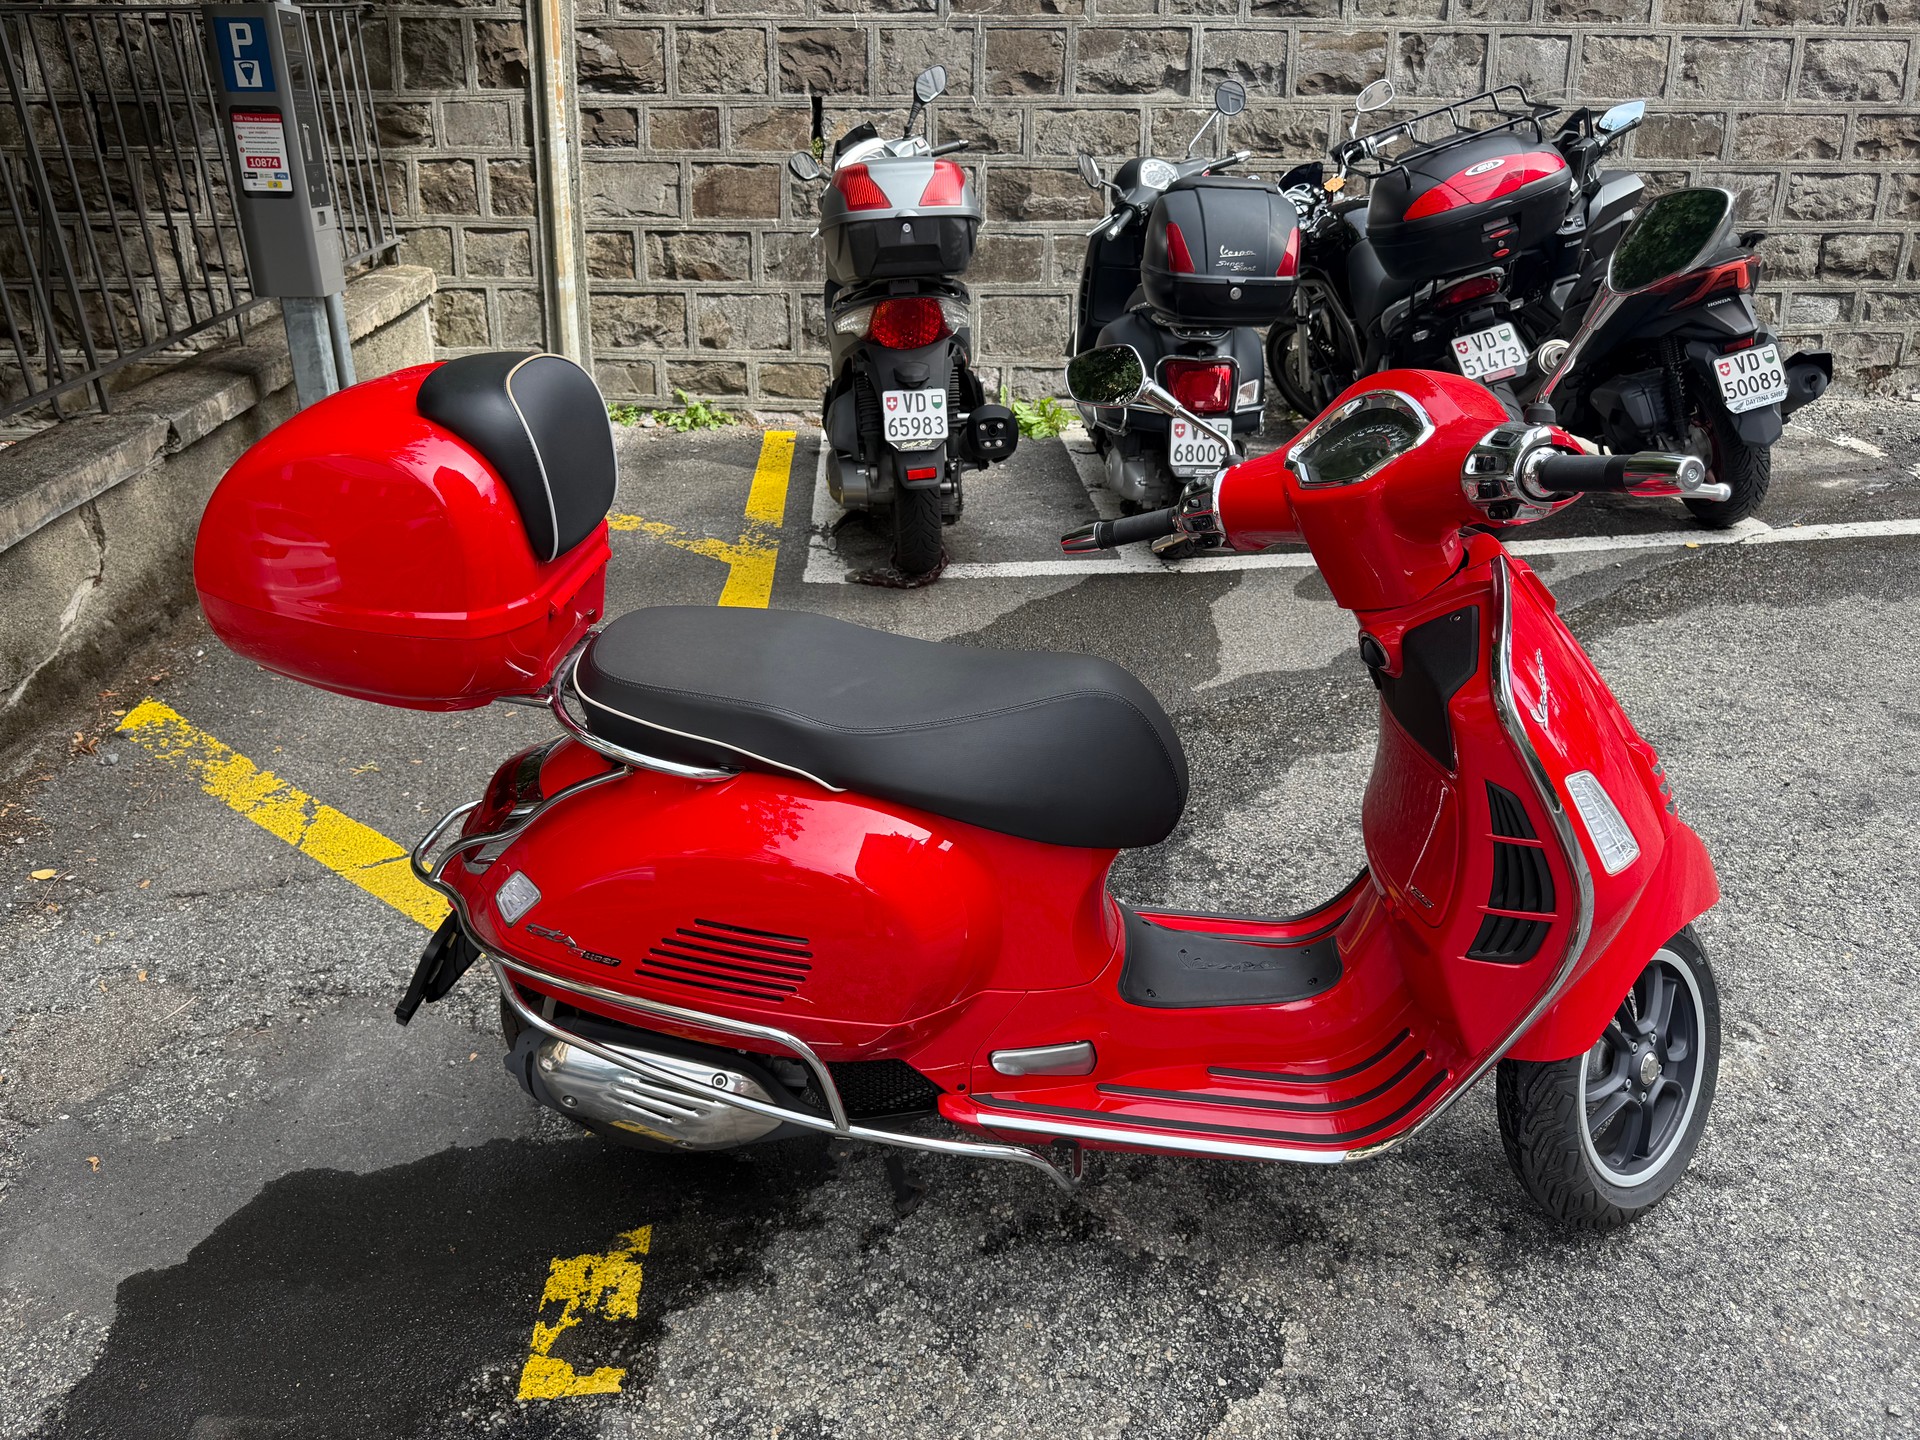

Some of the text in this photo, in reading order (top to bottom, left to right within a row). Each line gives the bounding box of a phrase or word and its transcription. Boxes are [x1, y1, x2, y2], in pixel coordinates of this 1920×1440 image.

[228, 22, 253, 58] P
[249, 158, 279, 167] 10874
[1219, 245, 1256, 258] Vespa
[1708, 297, 1732, 308] HONDA
[1471, 331, 1497, 352] VD
[1463, 346, 1521, 376] 51473
[1734, 352, 1760, 374] VD
[1724, 369, 1782, 400] 50089
[902, 393, 926, 413] VD
[888, 416, 944, 437] 65983
[1174, 444, 1227, 463] 68009
[1178, 948, 1286, 973] Vespa
